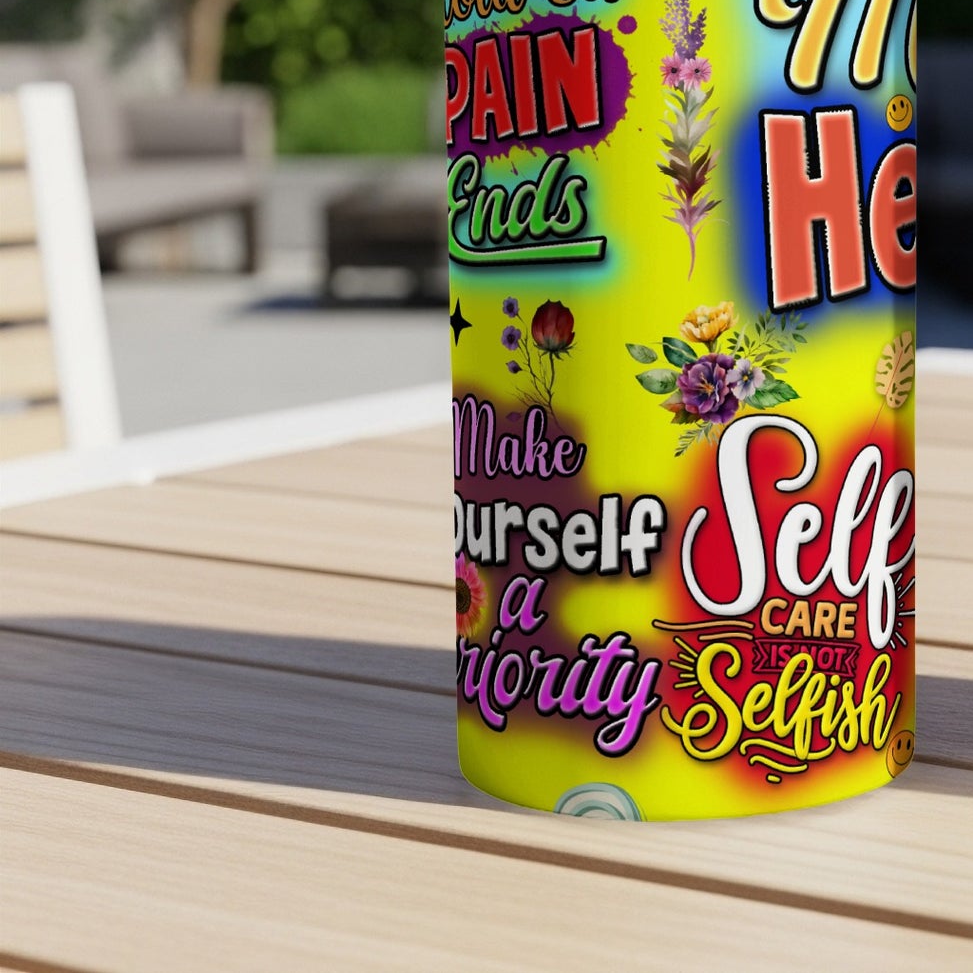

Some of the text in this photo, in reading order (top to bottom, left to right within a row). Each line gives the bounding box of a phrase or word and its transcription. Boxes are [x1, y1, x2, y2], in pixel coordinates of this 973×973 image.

[445, 23, 601, 145] PAIN
[448, 152, 607, 265] Ends
[453, 392, 586, 480] Make
[682, 414, 915, 650] Self
[499, 574, 547, 634] a
[761, 597, 858, 639] CARE
[661, 641, 901, 762] Selfish
[770, 644, 848, 670] IS NOT
